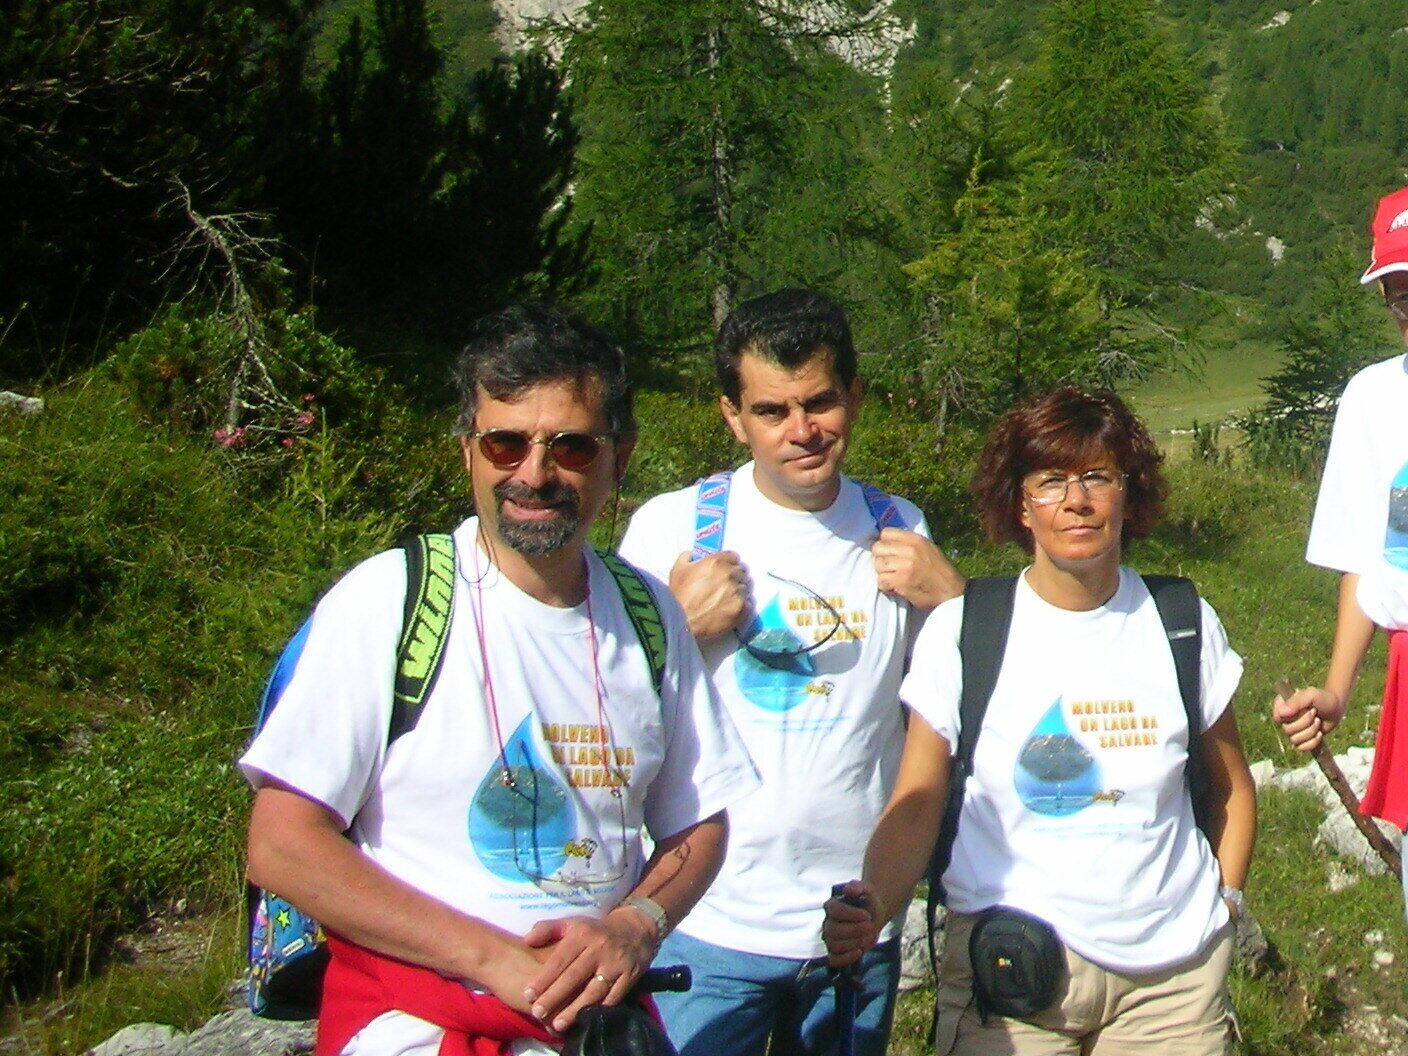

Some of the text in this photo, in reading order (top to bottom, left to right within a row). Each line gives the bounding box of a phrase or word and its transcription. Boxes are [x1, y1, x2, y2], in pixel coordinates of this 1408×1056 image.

[1072, 700, 1135, 715] MOLVENO
[1080, 715, 1158, 732] UN LAGO DA
[1099, 733, 1158, 748] SALVARE
[570, 746, 611, 766] LAGO
[615, 747, 635, 765] DA
